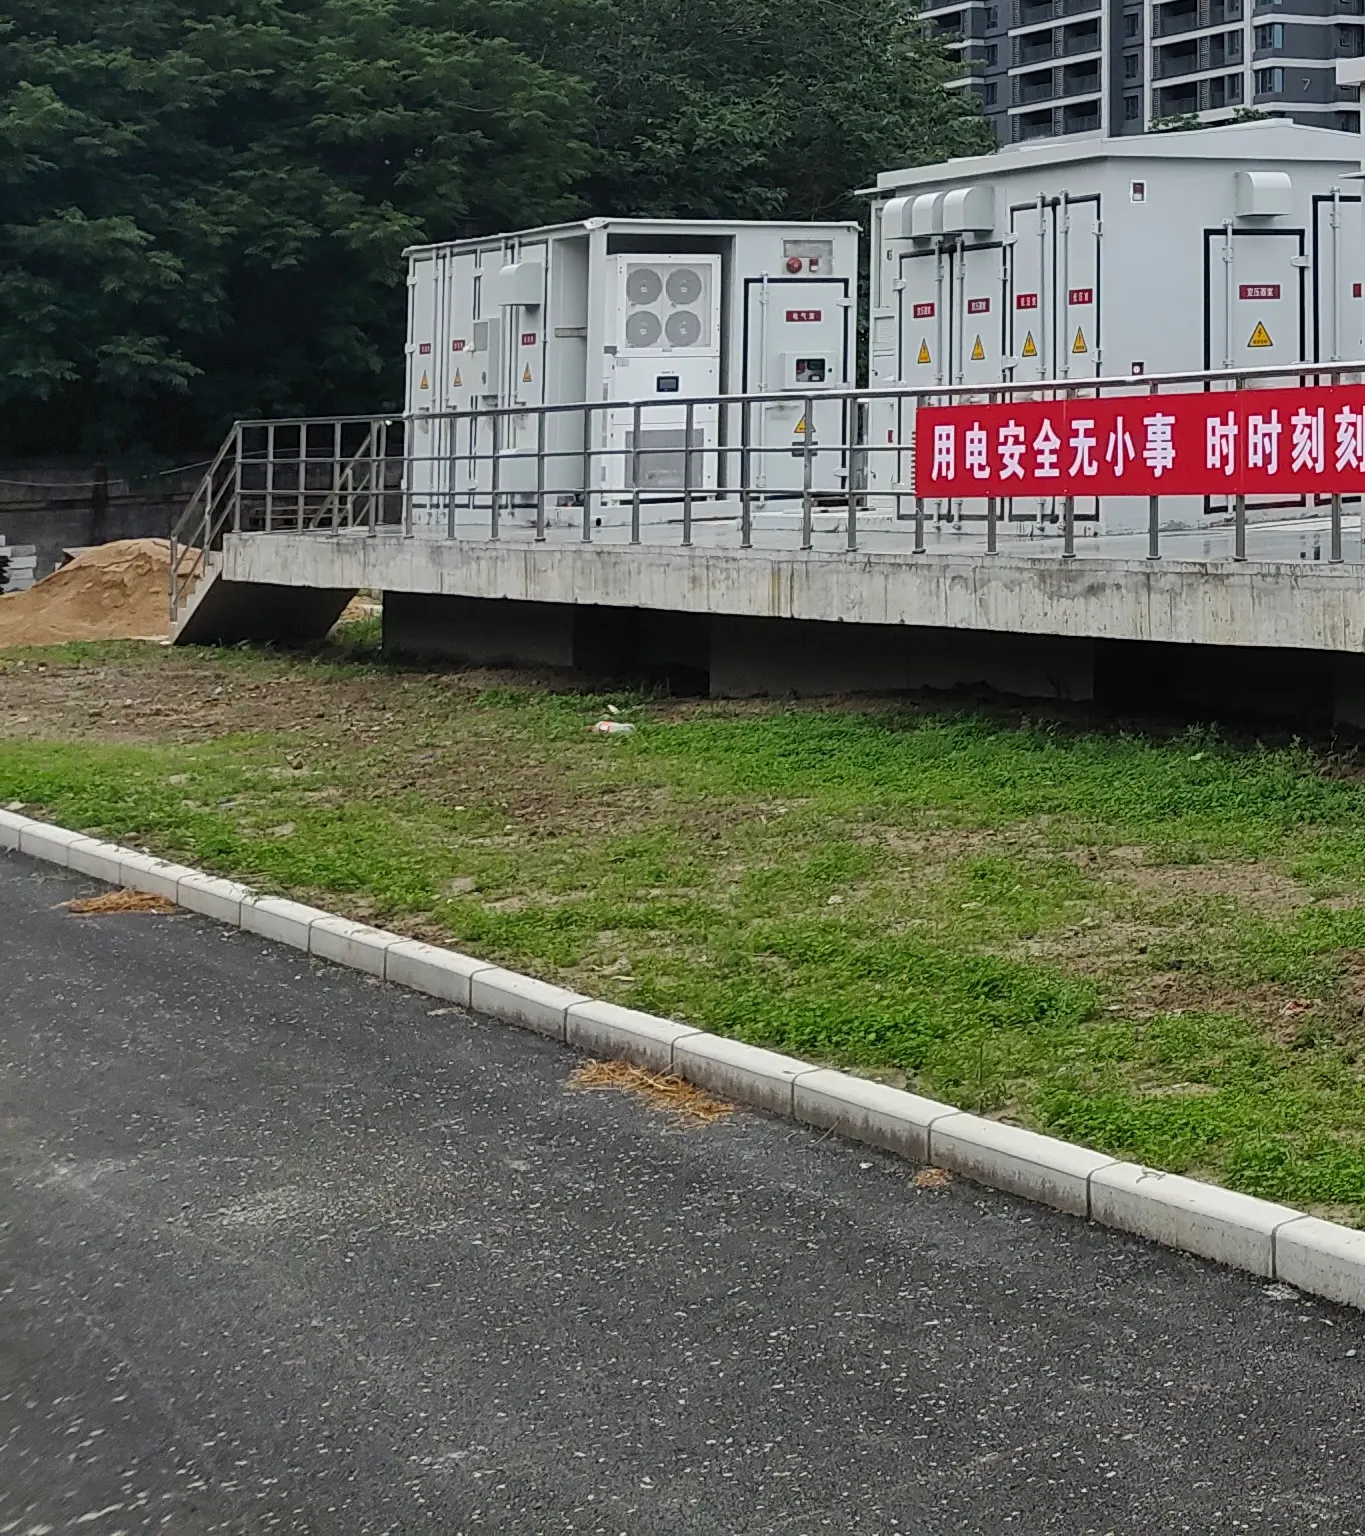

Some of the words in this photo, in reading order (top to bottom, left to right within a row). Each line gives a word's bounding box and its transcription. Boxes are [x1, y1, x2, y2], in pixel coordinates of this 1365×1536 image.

[931, 412, 1176, 481] 用电安全无小事
